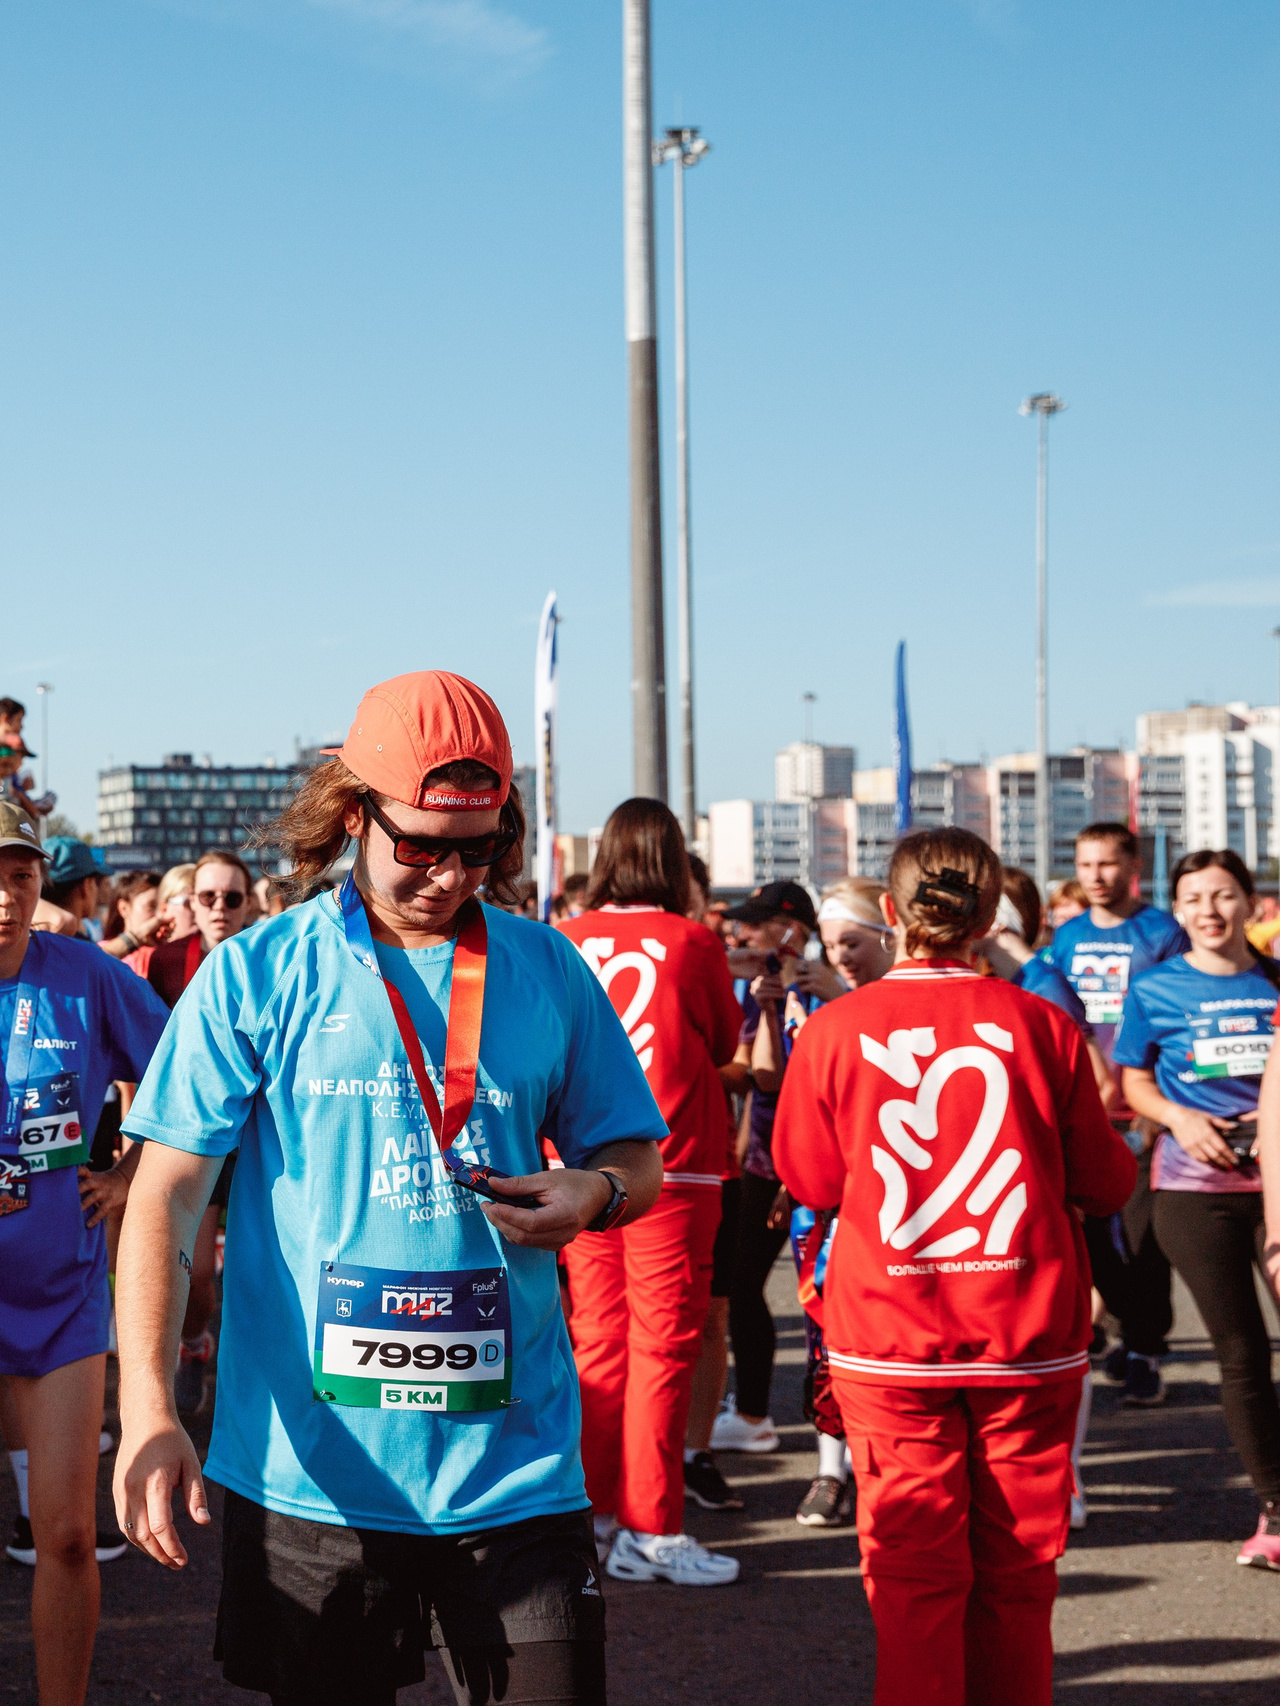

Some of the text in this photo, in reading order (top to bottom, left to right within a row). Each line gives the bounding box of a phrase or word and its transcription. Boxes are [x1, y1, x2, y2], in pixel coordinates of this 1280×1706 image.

[425, 794, 491, 806] RUNNING CLUB
[34, 1038, 78, 1050] САЛЮТ
[308, 1079, 419, 1099] ΝΕΑΠΟΛΗΣ
[68, 1125, 76, 1138] E
[887, 1262, 936, 1276] БОЛЬШЕ
[936, 1260, 963, 1273] ЧЕМ
[327, 1276, 365, 1288] купер
[472, 1282, 494, 1293] Fplus
[352, 1339, 499, 1370] 7999 D
[386, 1389, 402, 1403] 5
